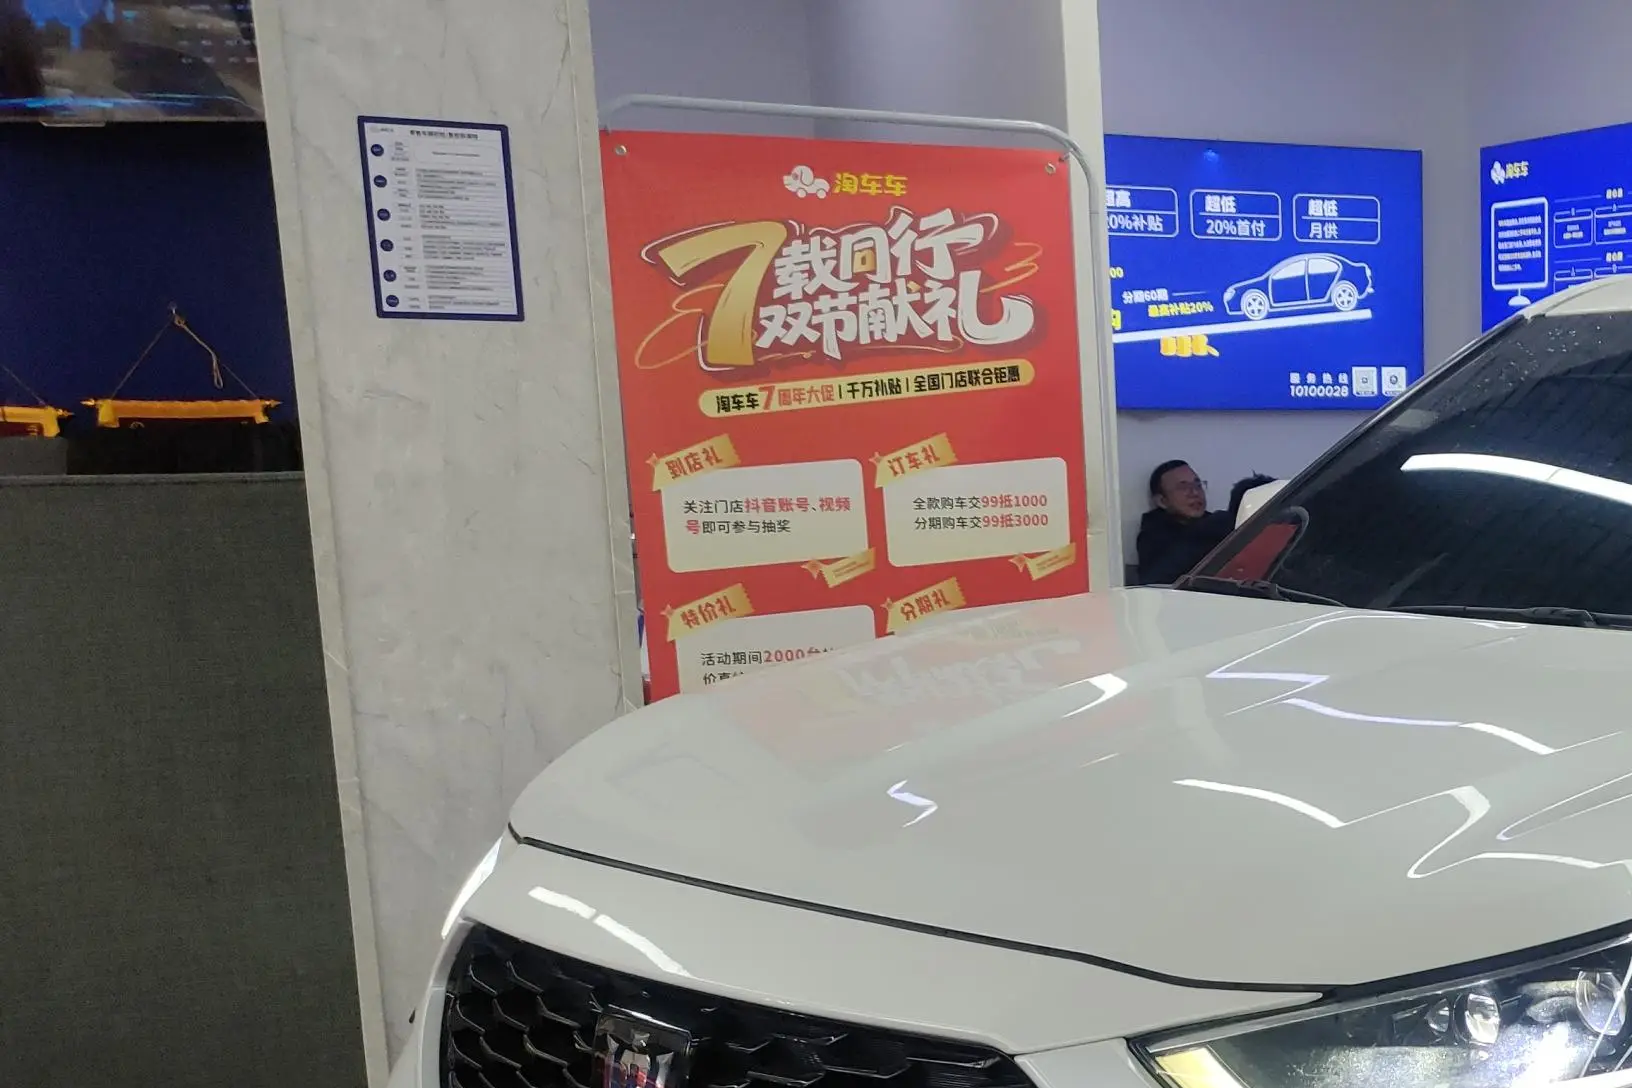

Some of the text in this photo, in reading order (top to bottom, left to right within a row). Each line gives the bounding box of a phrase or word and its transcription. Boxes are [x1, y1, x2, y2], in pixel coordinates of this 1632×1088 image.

[832, 172, 909, 197] 淘车车
[1205, 194, 1237, 213] 超低
[1307, 199, 1339, 217] 超低
[1206, 218, 1266, 238] 20%首付
[1308, 222, 1339, 239] 月供
[755, 270, 1034, 360] 双节献礼
[665, 444, 723, 479] 到店礼
[887, 444, 941, 477] 订车礼
[683, 496, 851, 514] 关注门店抖音账号、视频
[912, 494, 1048, 510] 全款购车交99抵1000
[686, 519, 791, 535] 号即可参与抽奖
[914, 513, 1049, 530] 分期购车交99抵3000
[680, 595, 737, 629] 特价礼
[900, 589, 950, 621] 分期礼
